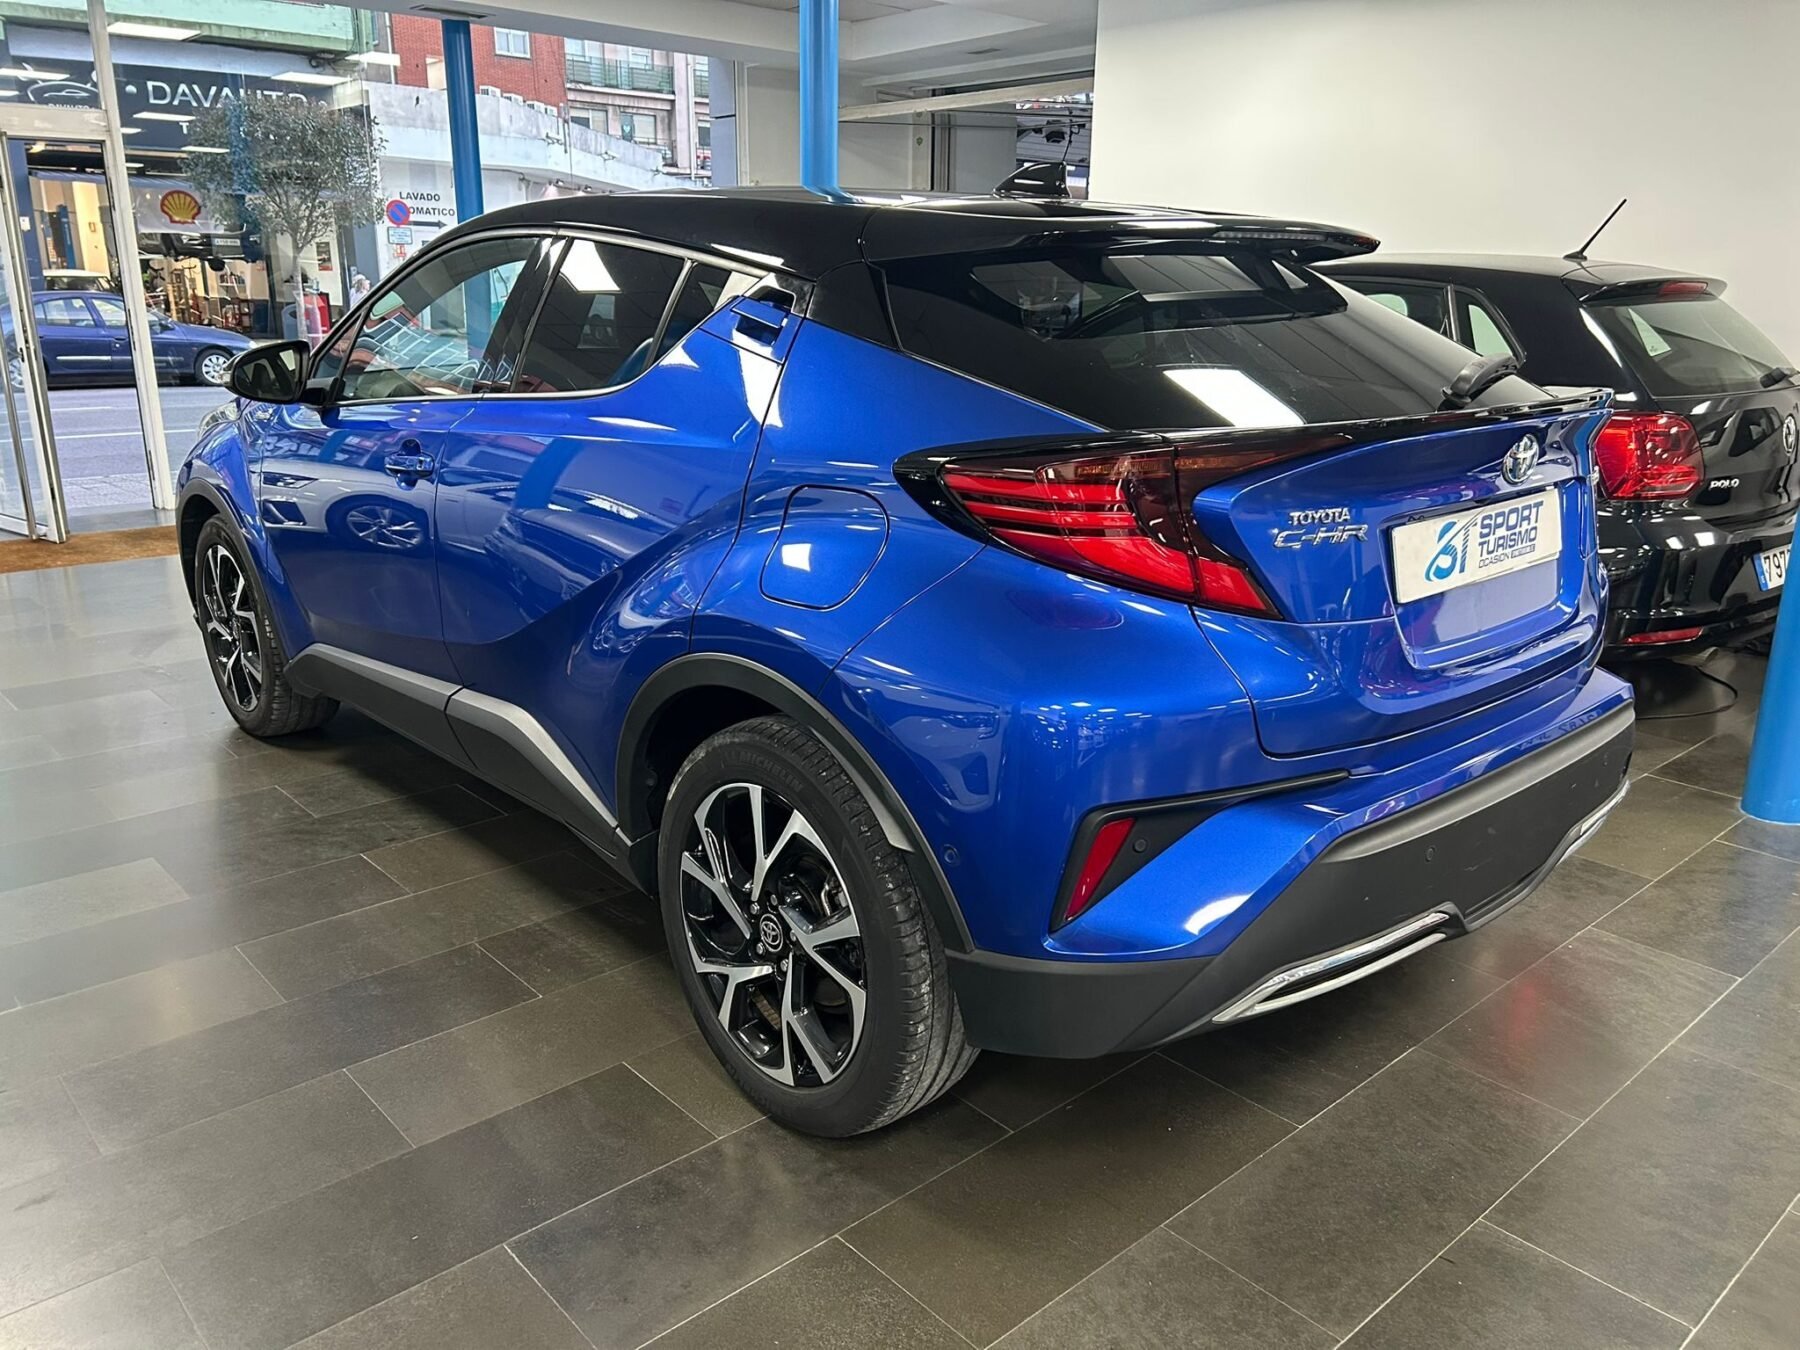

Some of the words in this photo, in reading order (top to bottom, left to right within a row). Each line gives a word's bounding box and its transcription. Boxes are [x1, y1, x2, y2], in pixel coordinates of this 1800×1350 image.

[399, 191, 441, 202] LAVADO
[408, 206, 456, 216] OMATICO
[1709, 478, 1740, 491] POLO
[1289, 507, 1351, 526] TOYOTA
[1479, 500, 1544, 539] SPORT
[1272, 524, 1368, 548] C-HR
[1478, 526, 1538, 557] TURISMO
